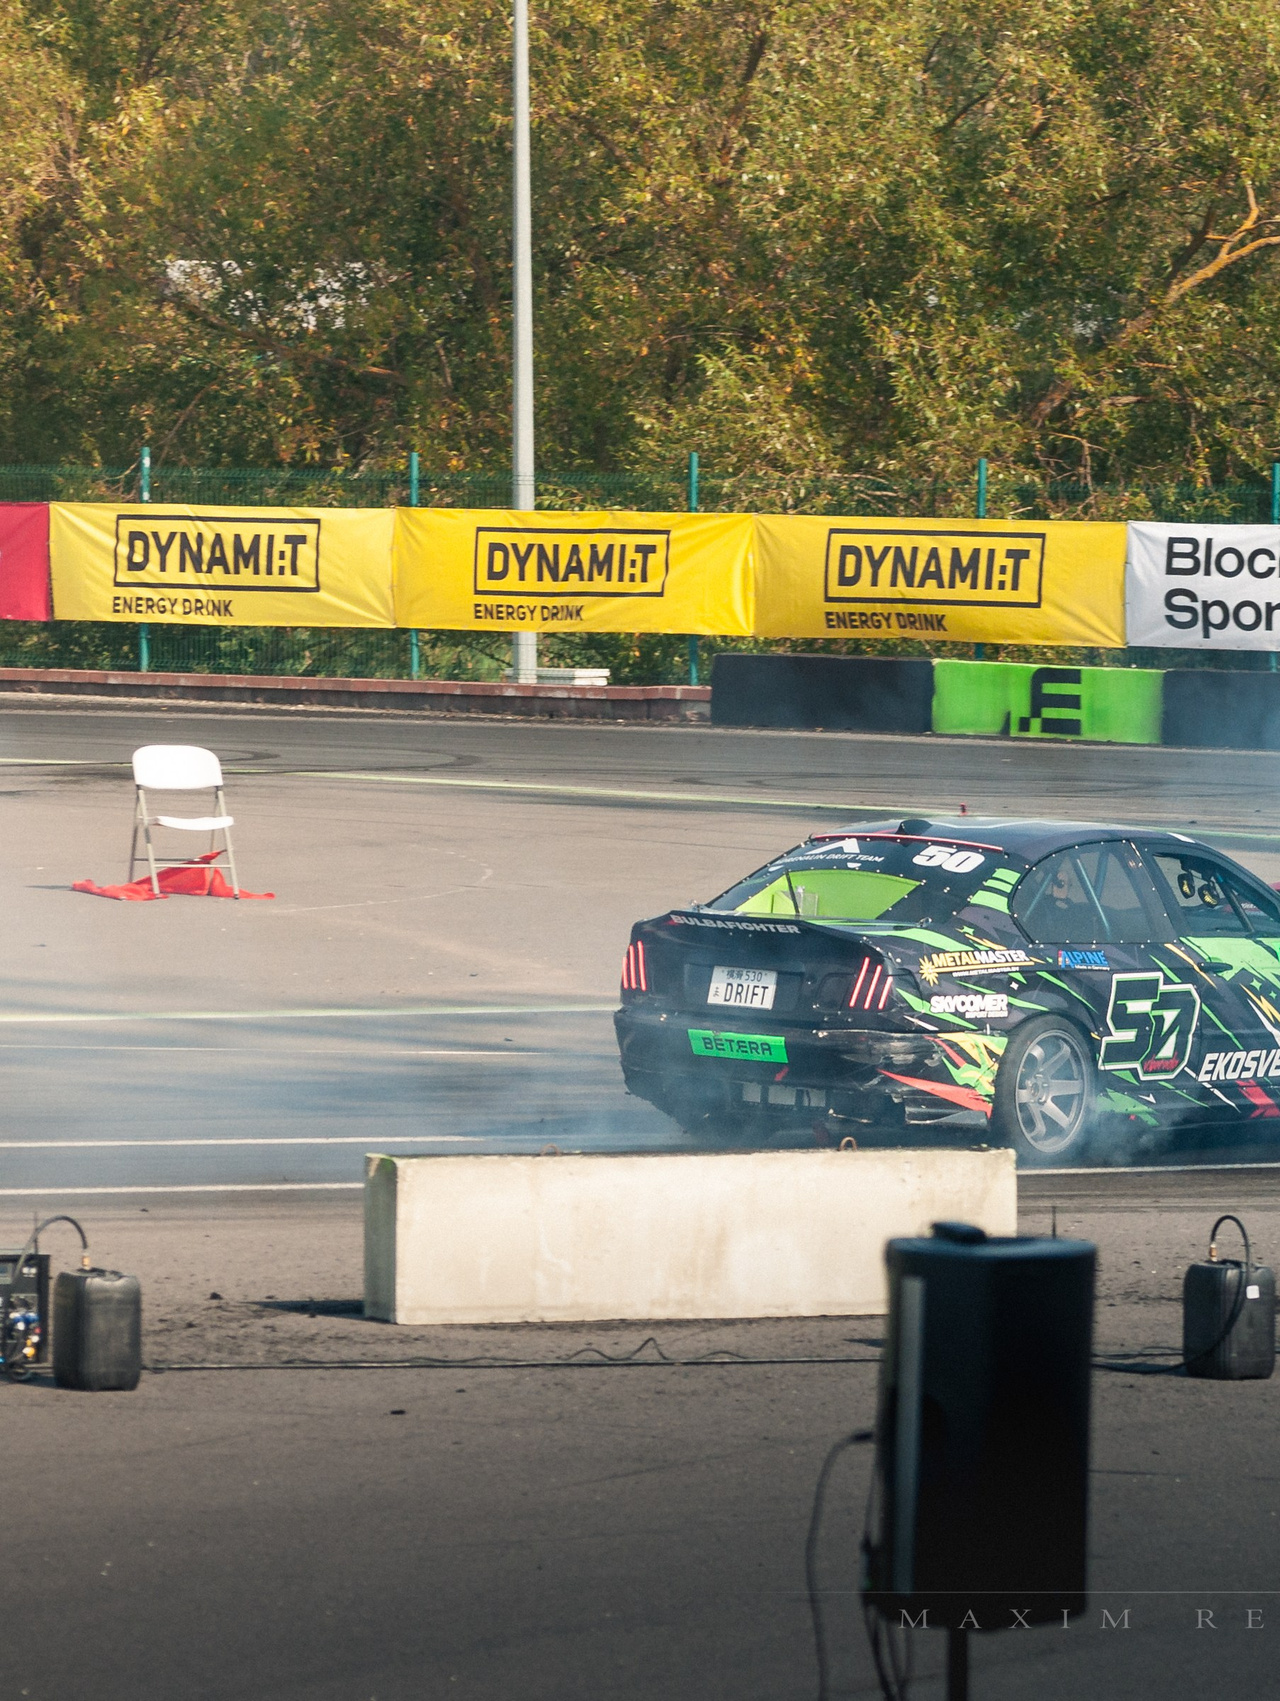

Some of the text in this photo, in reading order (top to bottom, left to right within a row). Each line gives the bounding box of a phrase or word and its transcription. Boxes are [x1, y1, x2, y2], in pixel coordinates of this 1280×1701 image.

[113, 596, 233, 617] ENERGY DRINK
[473, 603, 584, 622] ENERGY DRINK
[825, 611, 948, 632] ENERGY DRINK
[825, 853, 856, 861] DRIFT
[855, 854, 885, 863] TEAM
[912, 845, 985, 873] 50
[670, 914, 801, 934] BULBAFIGHTER
[932, 950, 1030, 968] METALMASTER
[1060, 950, 1108, 969] ALPINE
[744, 970, 763, 982] 530
[723, 982, 769, 1006] DRIFT
